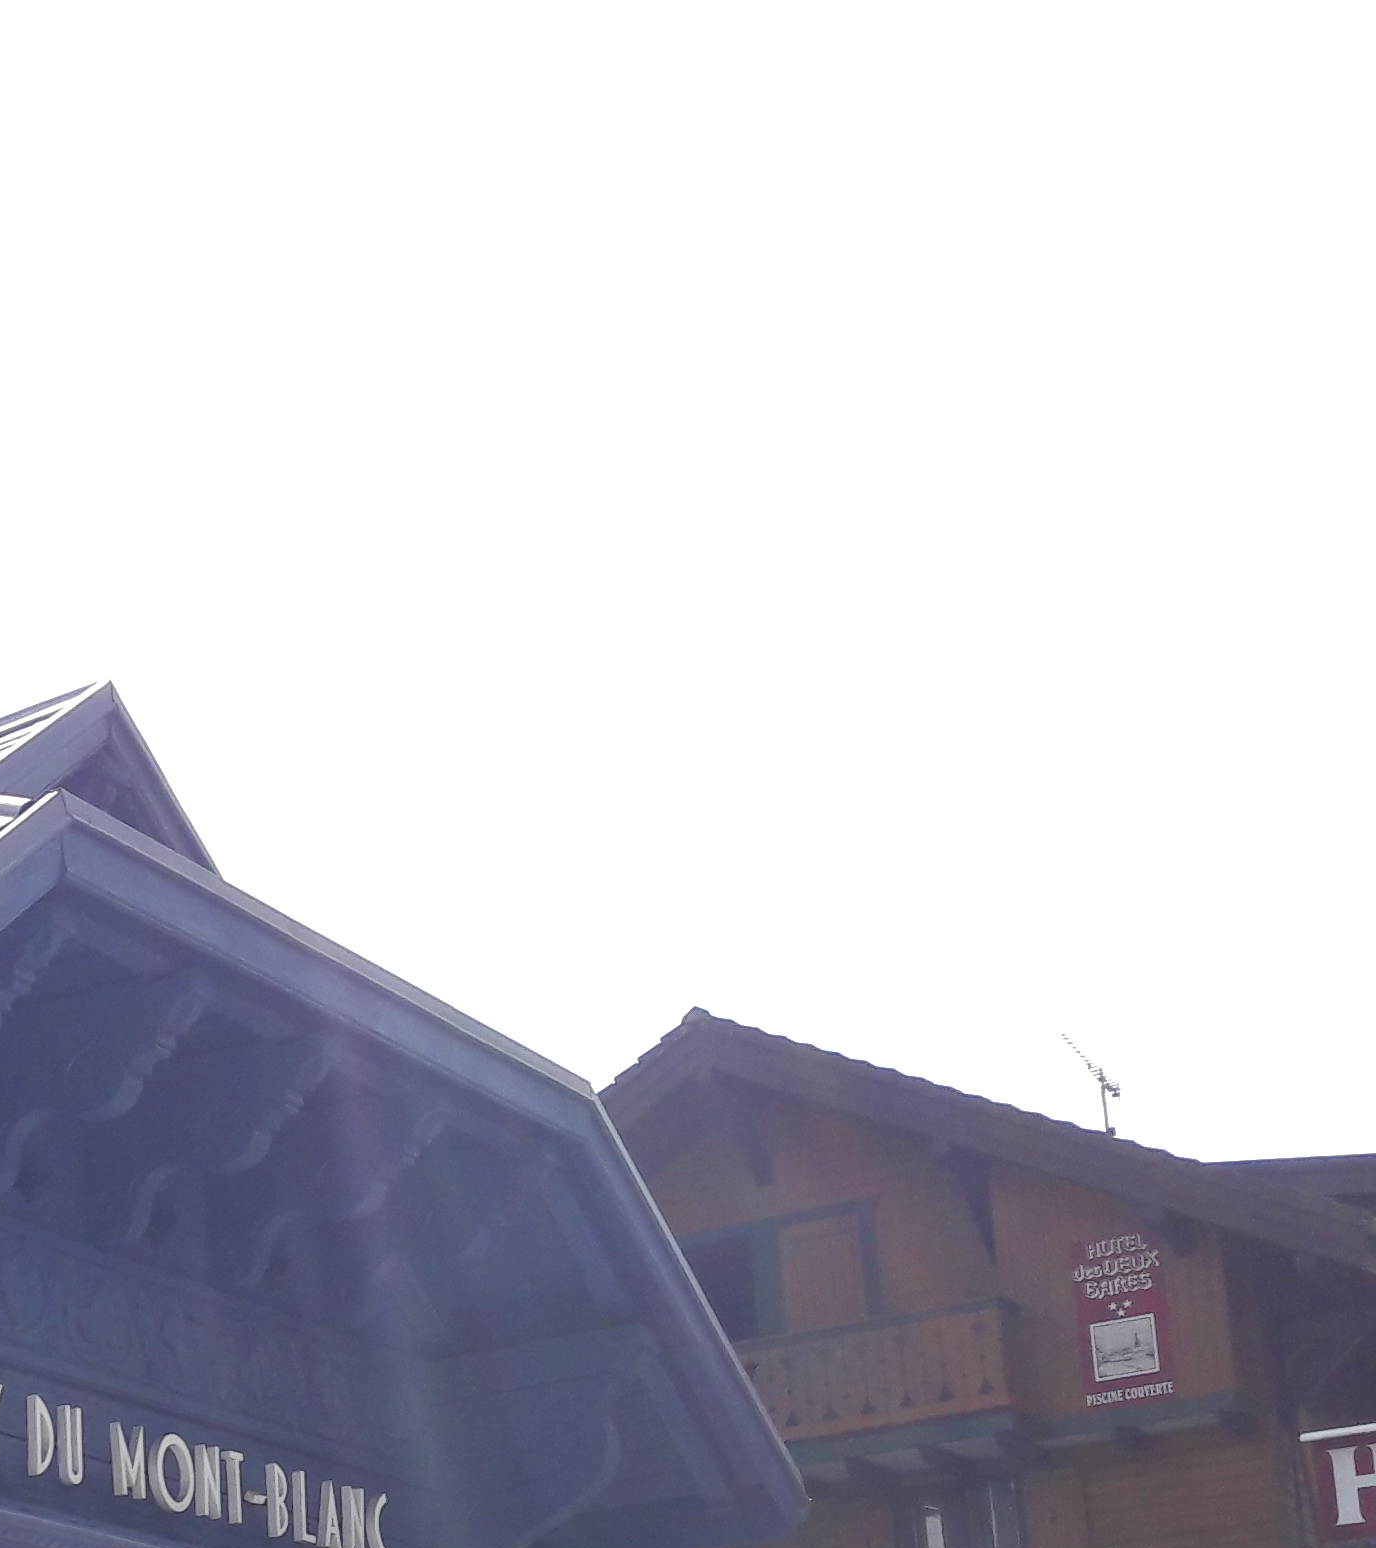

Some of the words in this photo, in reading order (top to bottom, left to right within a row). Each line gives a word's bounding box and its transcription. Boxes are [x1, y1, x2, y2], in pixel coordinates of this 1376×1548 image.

[1086, 1232, 1148, 1260] HOTEL
[1073, 1264, 1103, 1282] des
[1103, 1248, 1161, 1277] DEUX
[1085, 1271, 1153, 1300] GARES
[1085, 1388, 1125, 1408] PISCINE
[1124, 1380, 1175, 1402] COUVERTE
[25, 1392, 86, 1486] DU
